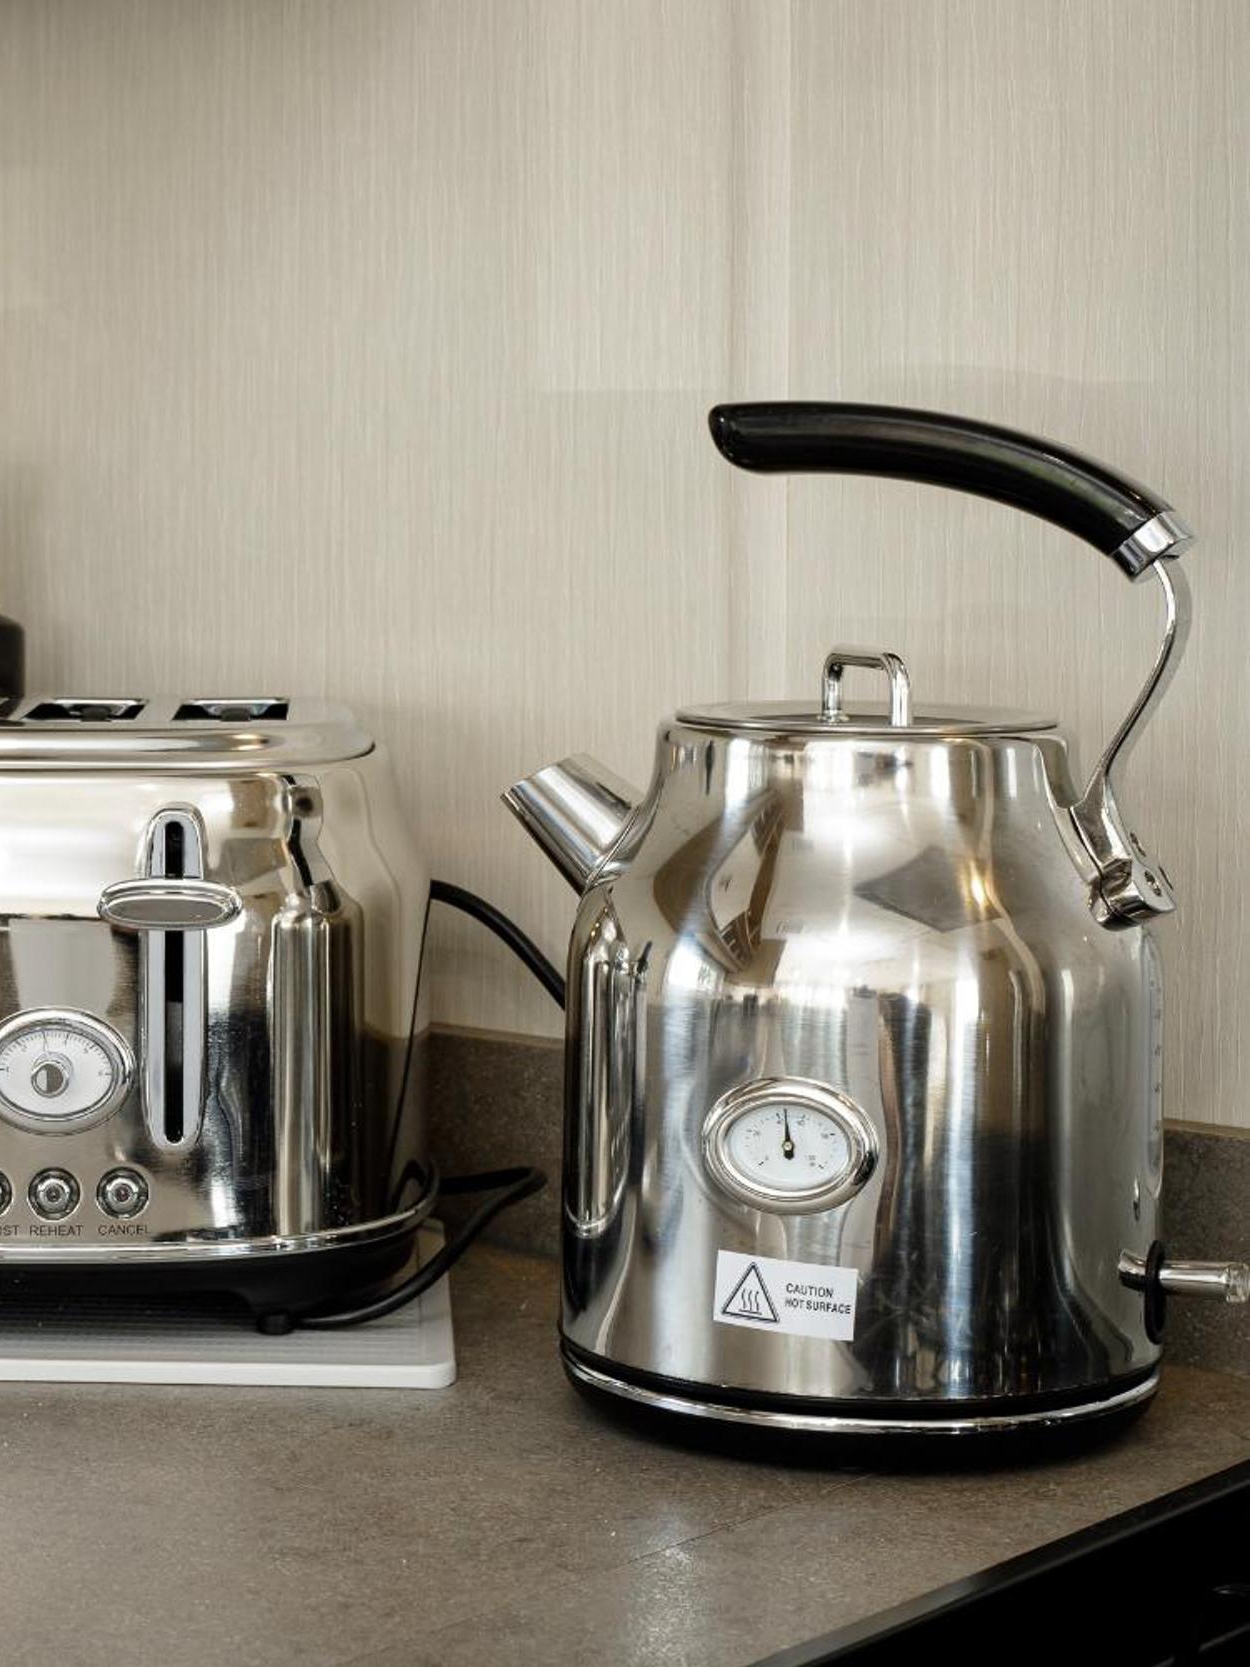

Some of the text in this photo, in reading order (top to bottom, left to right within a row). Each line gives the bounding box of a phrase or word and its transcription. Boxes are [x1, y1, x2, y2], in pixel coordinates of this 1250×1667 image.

[29, 1224, 84, 1237] REHEAT
[97, 1223, 151, 1236] CANCEL
[785, 1282, 834, 1299] CAUTION
[784, 1297, 852, 1315] HOT SURFACE
